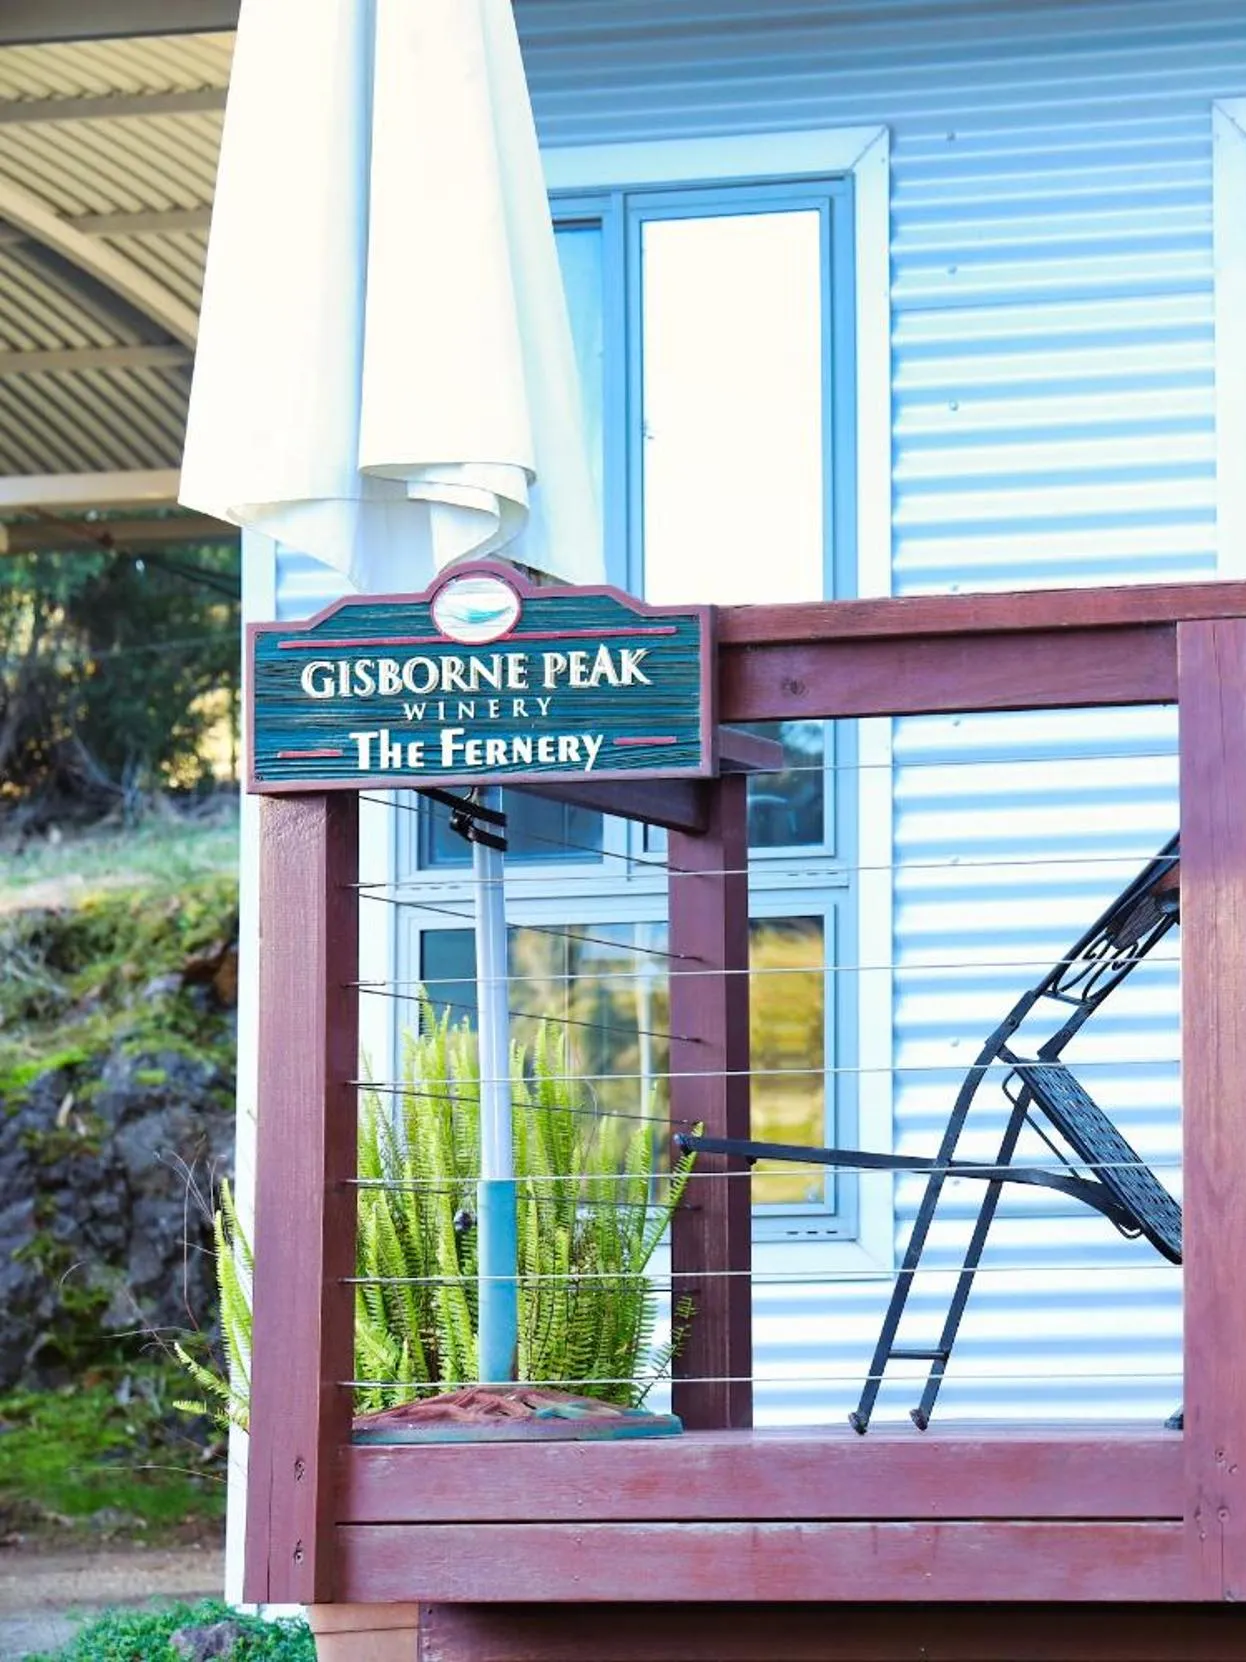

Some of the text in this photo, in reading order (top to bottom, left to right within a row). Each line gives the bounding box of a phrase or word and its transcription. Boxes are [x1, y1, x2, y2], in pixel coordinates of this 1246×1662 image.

[301, 645, 652, 698] GISBORNE PEAK
[402, 697, 552, 721] WINERY
